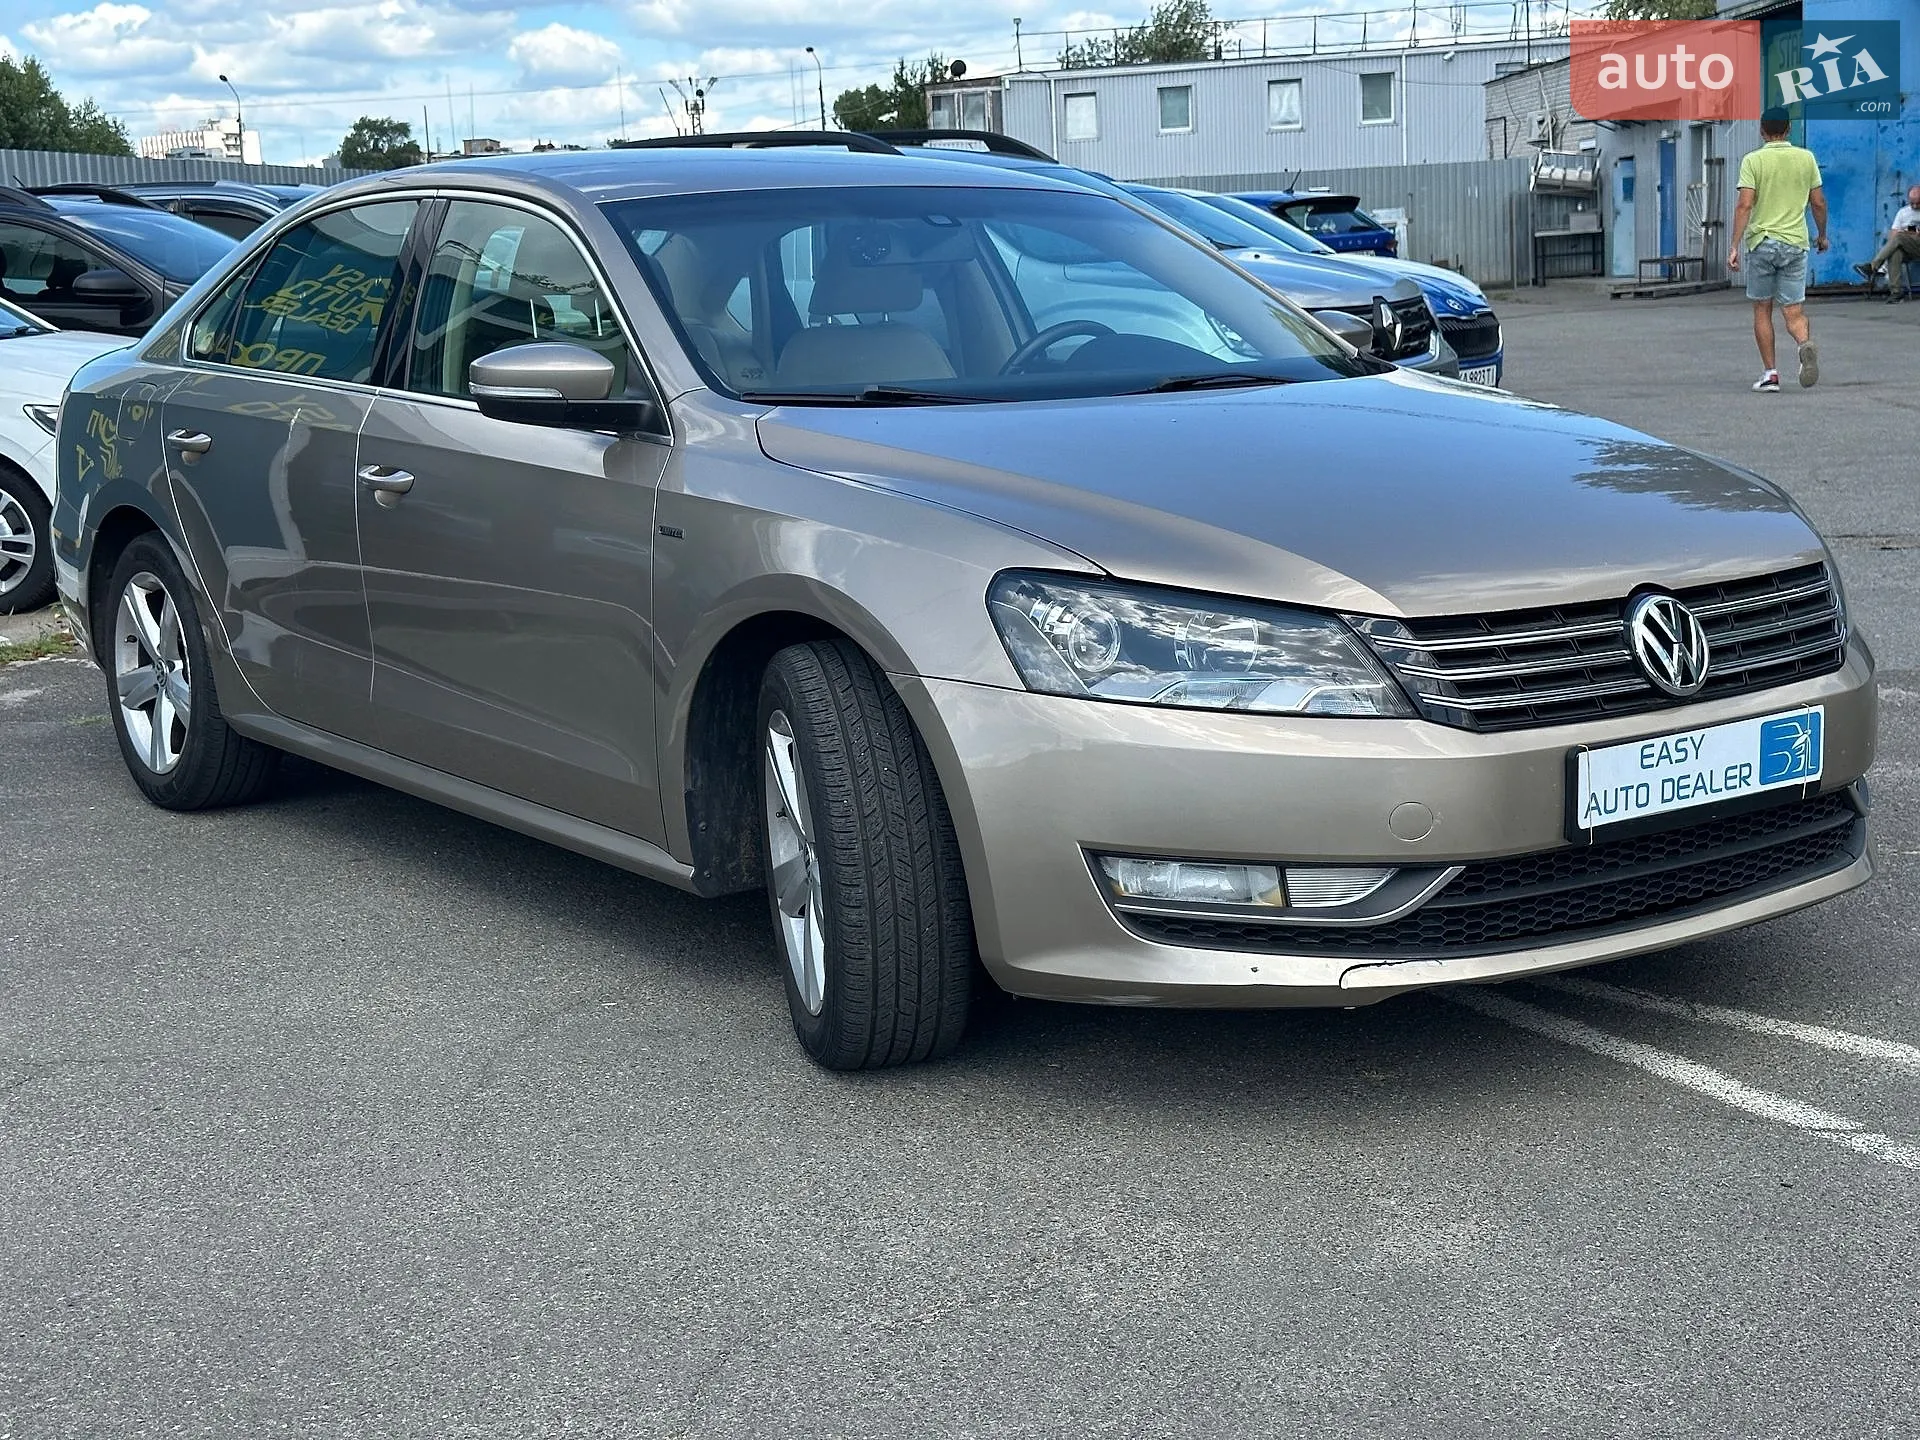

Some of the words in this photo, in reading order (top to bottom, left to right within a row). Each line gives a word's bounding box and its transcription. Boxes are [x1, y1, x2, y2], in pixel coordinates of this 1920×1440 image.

[1640, 733, 1706, 770] EASY
[1583, 782, 1650, 819] AUTO
[1660, 762, 1752, 804] DEALER
